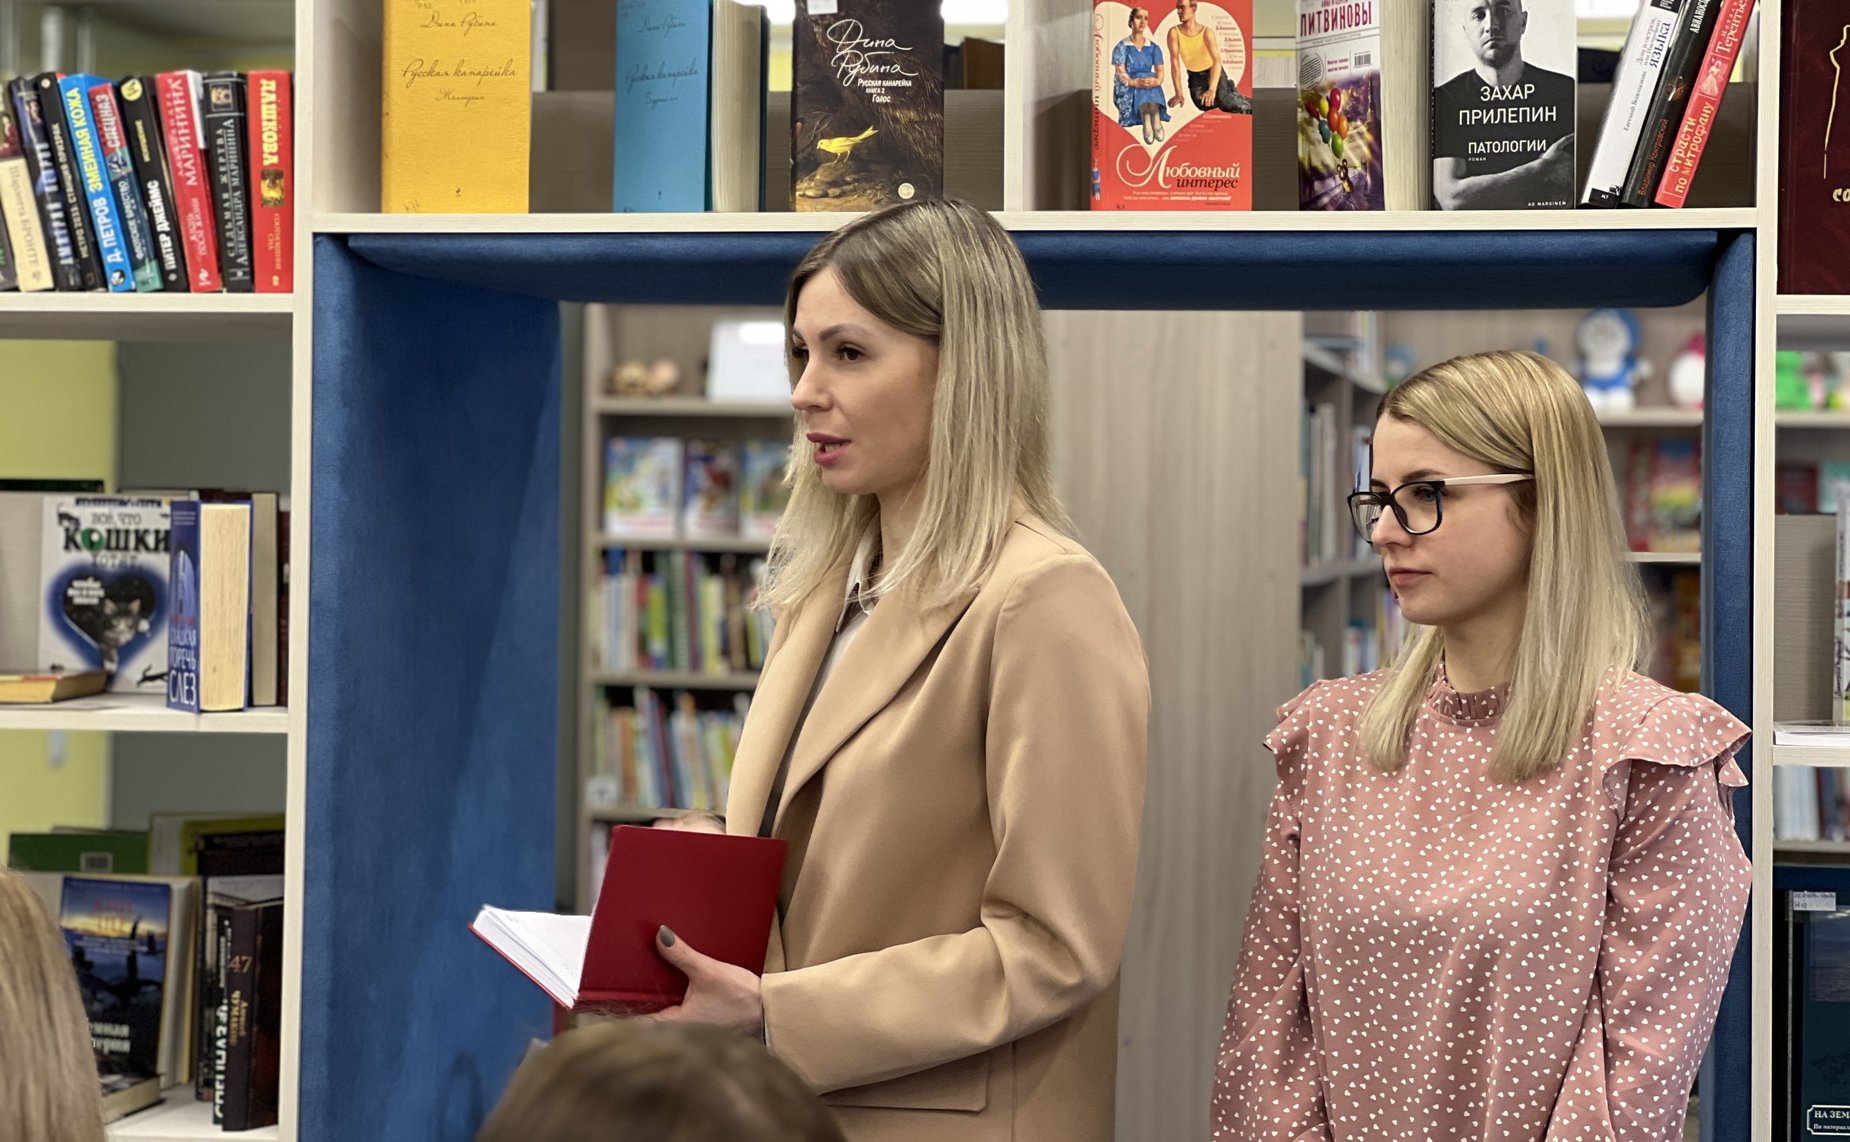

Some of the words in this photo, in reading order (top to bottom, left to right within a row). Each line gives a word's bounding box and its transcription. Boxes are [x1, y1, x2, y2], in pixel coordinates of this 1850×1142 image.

[826, 18, 912, 53] Дина
[1300, 3, 1372, 37] ЛИТВИНОВЫ
[1649, 22, 1671, 68] языка
[402, 59, 449, 88] Русская
[453, 59, 517, 87] канарейка
[831, 50, 919, 87] Рубина
[66, 87, 87, 128] КОЖА
[1480, 84, 1535, 101] ЗАХАР
[95, 94, 121, 148] СПЕЦНАЗ
[169, 78, 198, 186] МАРИНИНА
[260, 78, 278, 165] ДАШКОВА
[1459, 106, 1557, 125] ПРИЛЕПИН
[75, 127, 103, 193] ЗМЕИНАЯ
[216, 127, 229, 184] ЖЕРТВА
[220, 118, 241, 187] МАРИНИНА
[1116, 144, 1240, 188] Любовный
[1468, 139, 1547, 154] ПАТОЛОГИИ
[1637, 162, 1656, 196] Владимир
[1650, 118, 1669, 161] Контровский
[1176, 178, 1238, 191] интерес
[93, 197, 117, 248] ПЕТРОВ
[147, 180, 171, 232] ДЖЕЙМС
[222, 191, 236, 258] СЕДЬМАЯ
[232, 190, 248, 265] АЛЕКСАНДРА
[106, 247, 124, 263] Д.
[158, 233, 177, 270] ПИТЕР
[64, 528, 170, 553] КОШКИ
[169, 671, 196, 706] СЛЕЗ
[229, 955, 253, 974] 47
[1814, 1110, 1828, 1118] НА
